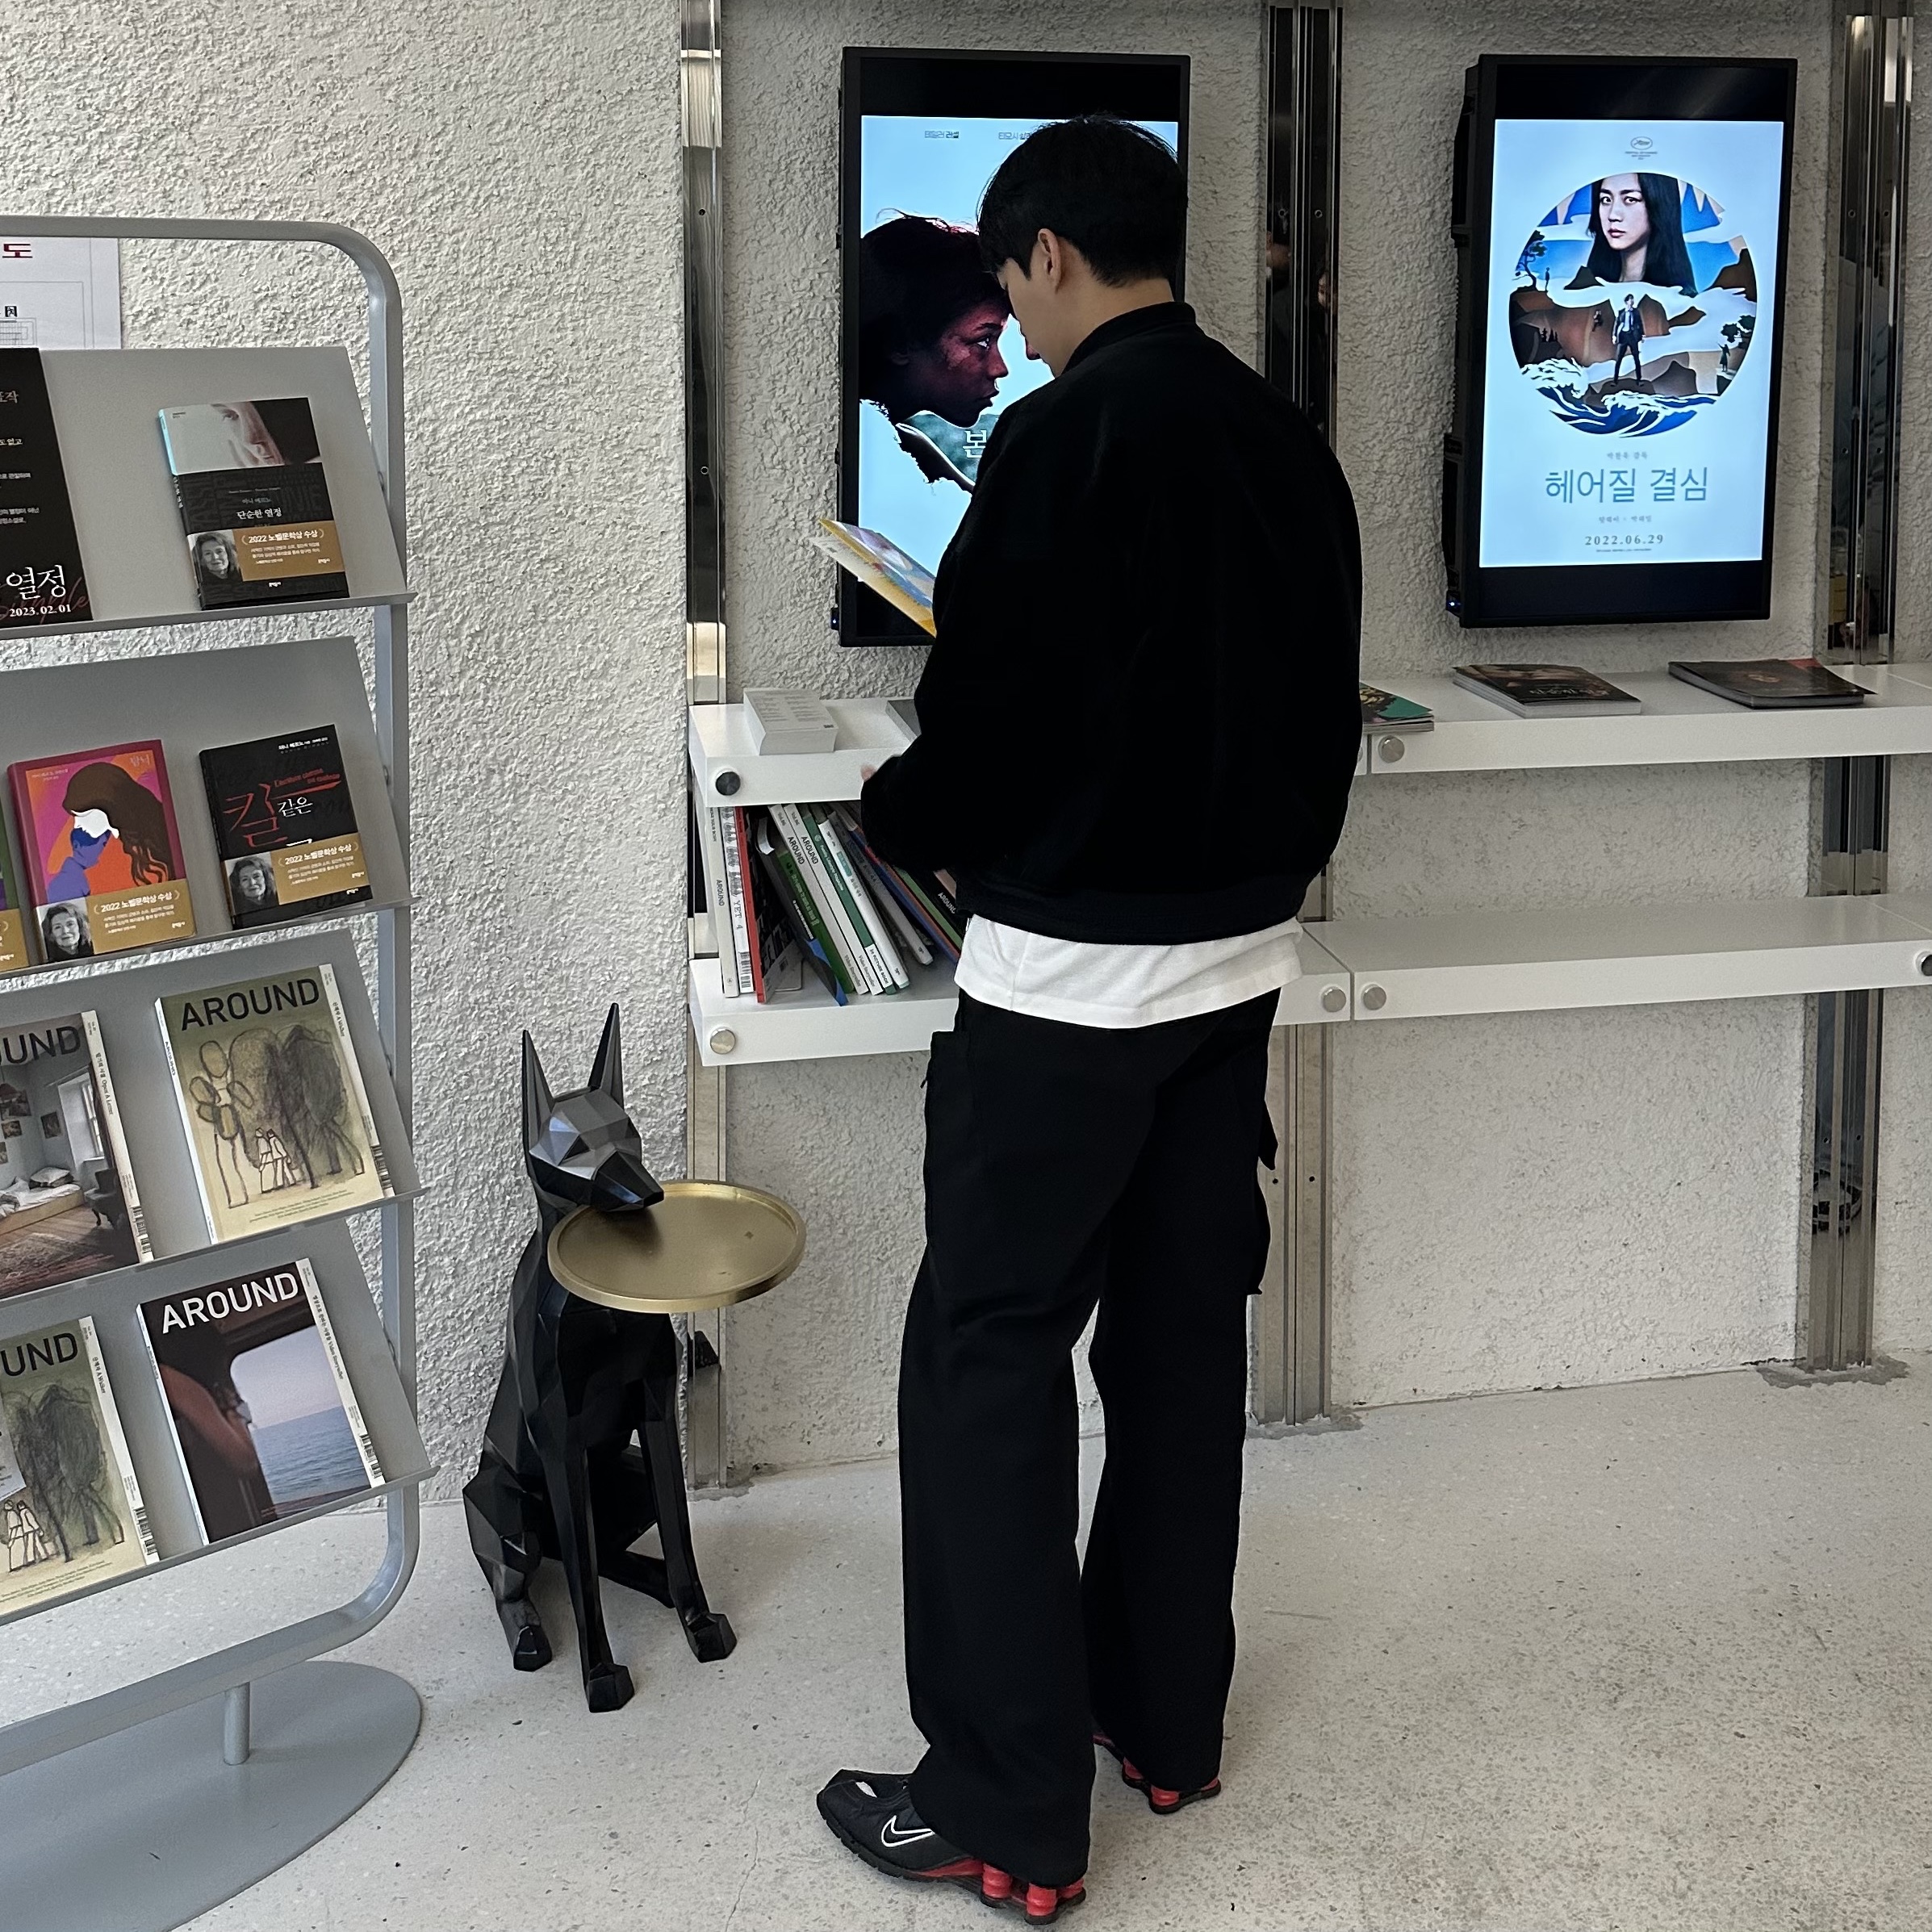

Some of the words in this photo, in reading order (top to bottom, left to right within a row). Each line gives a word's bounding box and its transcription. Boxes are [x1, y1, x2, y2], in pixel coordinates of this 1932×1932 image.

[1545, 468, 1636, 504] 헤어질
[1650, 466, 1708, 502] 결심
[248, 535, 268, 544] 2022
[1584, 533, 1664, 546] 2022.06.29
[6, 564, 66, 600] 열정
[9, 604, 72, 617] 2023.02.01
[223, 781, 329, 847] 칼
[277, 796, 314, 818] 같은
[285, 855, 303, 865] 2022
[788, 836, 805, 865] AROUND
[801, 836, 819, 864] AROUND
[716, 879, 726, 907] AROUND
[100, 902, 120, 913] 2022
[181, 977, 320, 1031] AROUND
[0, 1026, 81, 1064] UND
[162, 1272, 299, 1335] AROUND
